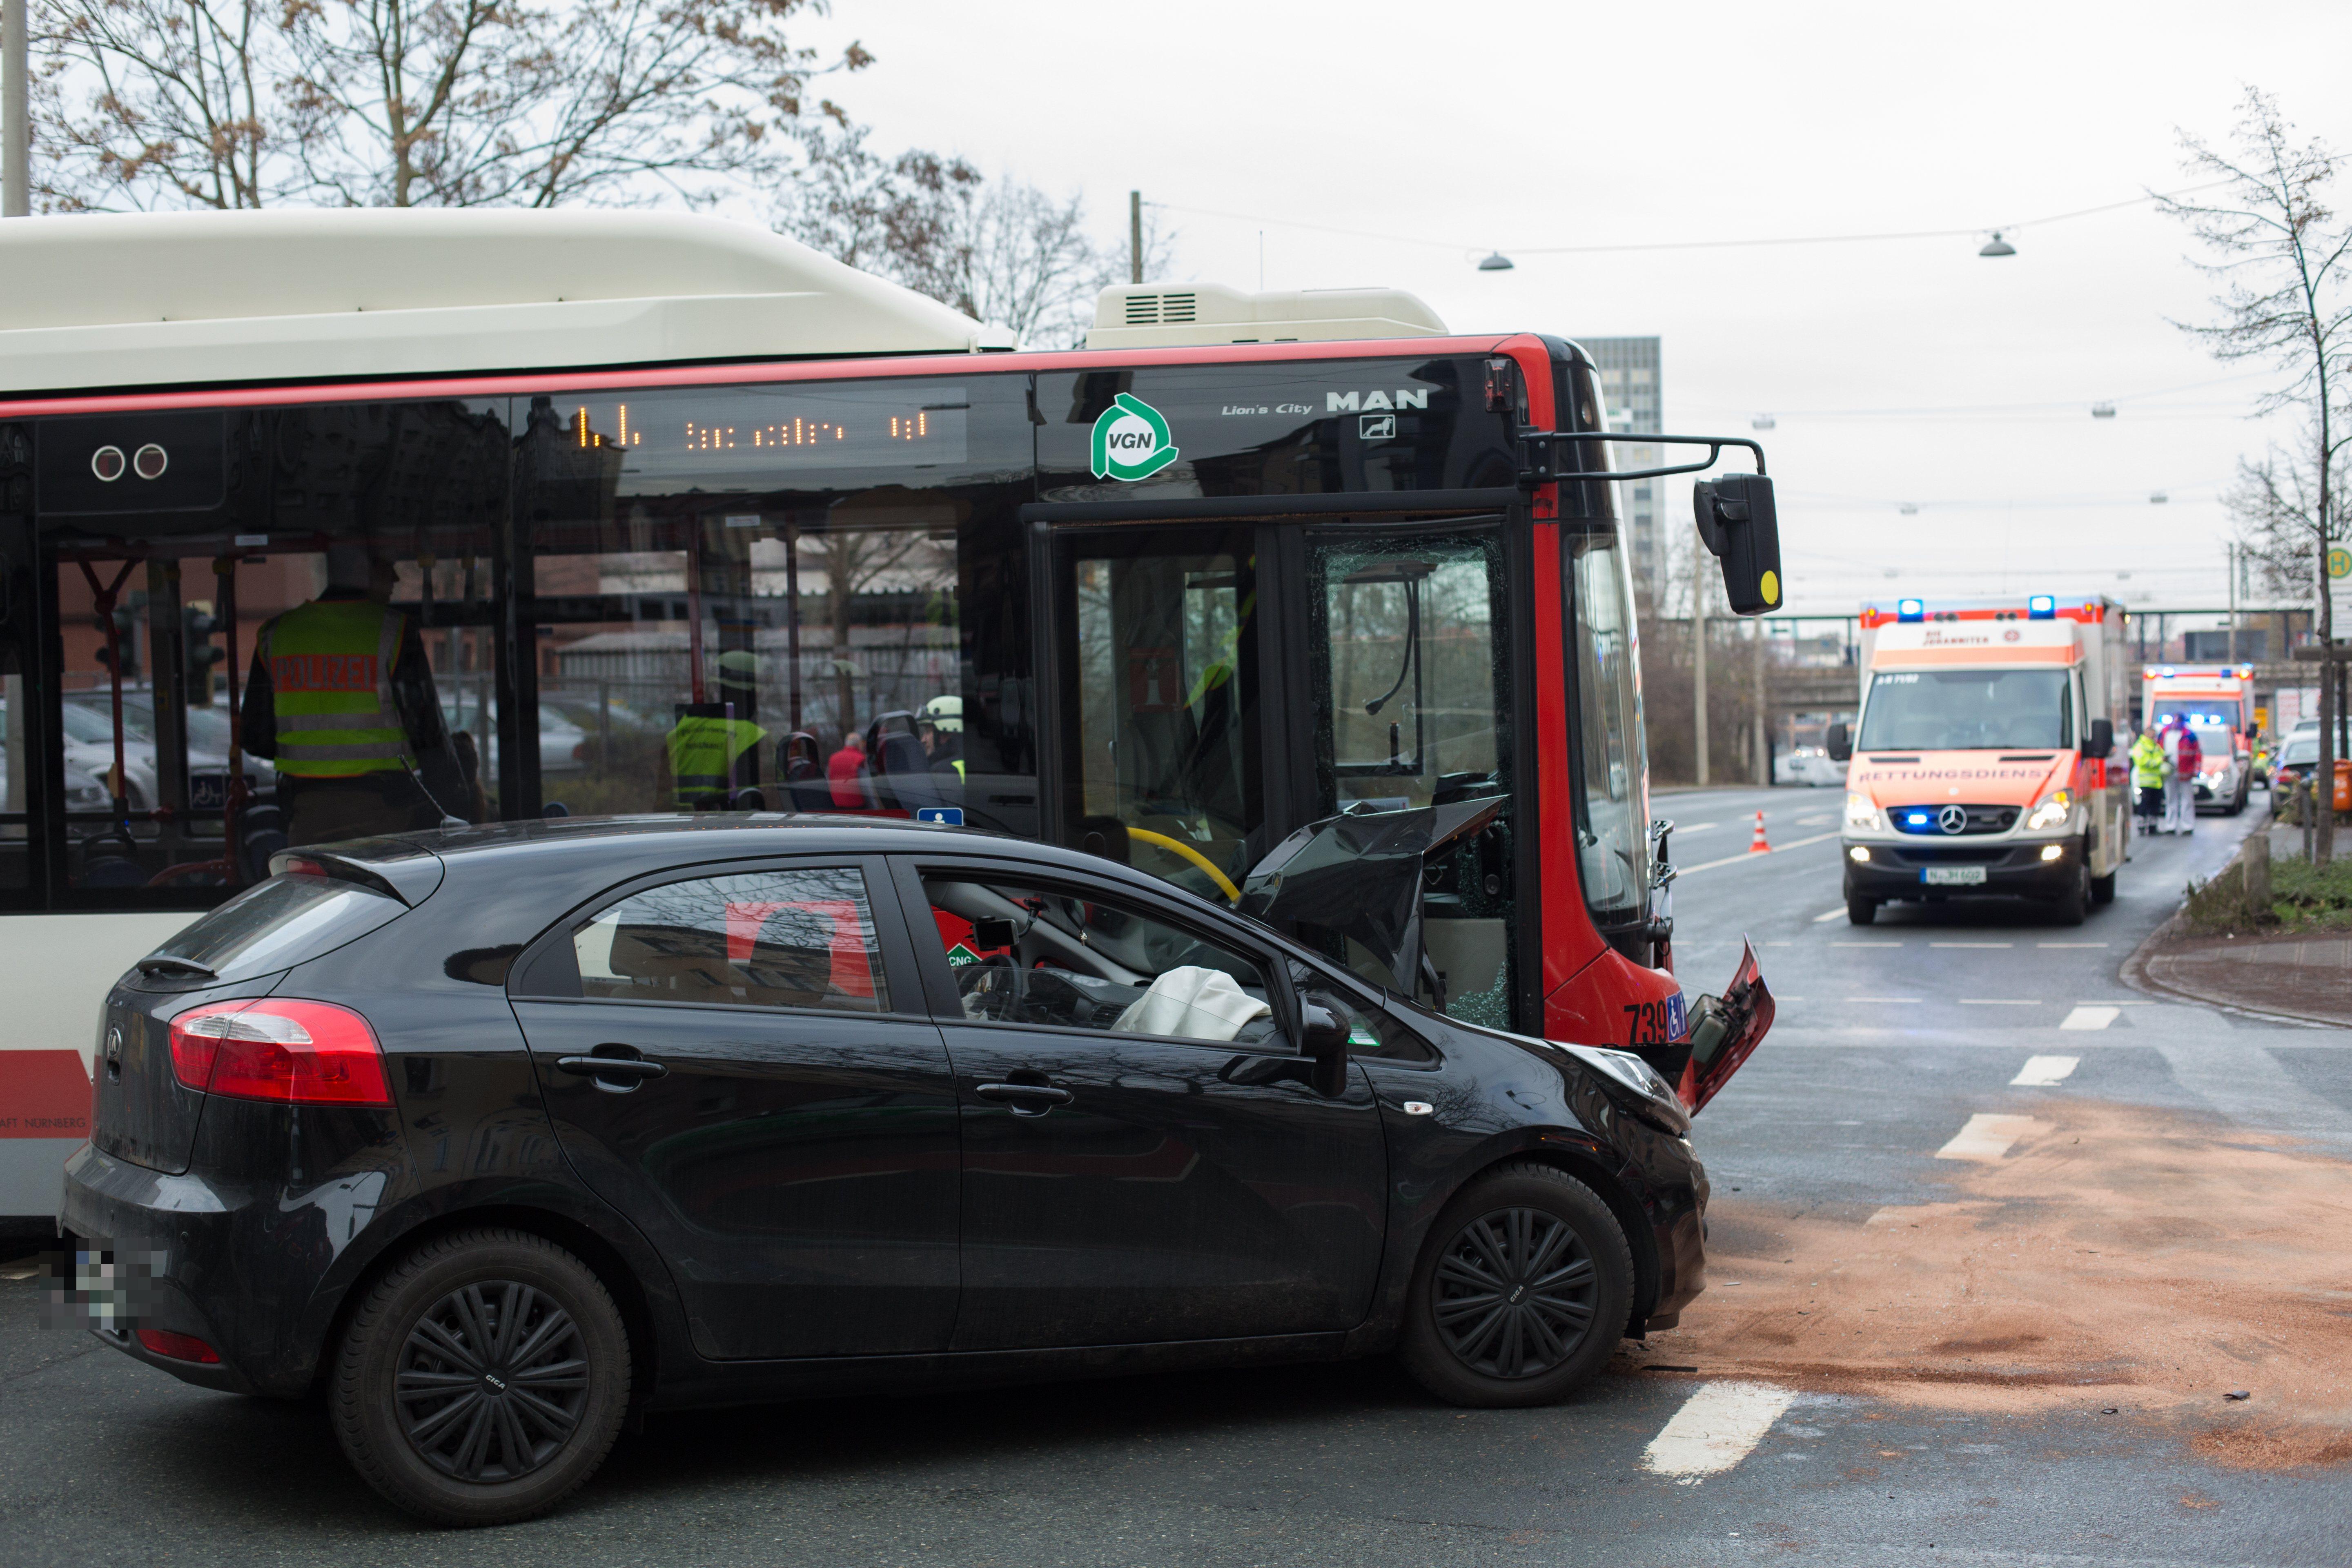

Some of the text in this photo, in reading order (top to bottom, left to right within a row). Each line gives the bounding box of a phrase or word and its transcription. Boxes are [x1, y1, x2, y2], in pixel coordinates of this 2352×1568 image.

[1327, 389, 1427, 411] MAN
[1222, 403, 1313, 415] Lion's City
[1109, 433, 1152, 449] VGN
[276, 656, 370, 690] POLIZEI
[1859, 768, 2058, 783] RETTUNGSDIENST
[949, 956, 971, 966] CNG
[1624, 999, 1667, 1046] 739
[0, 1117, 86, 1128] AFT NÜRNBERG
[1510, 1285, 1524, 1303] GIGA
[486, 1375, 506, 1389] GIGA
